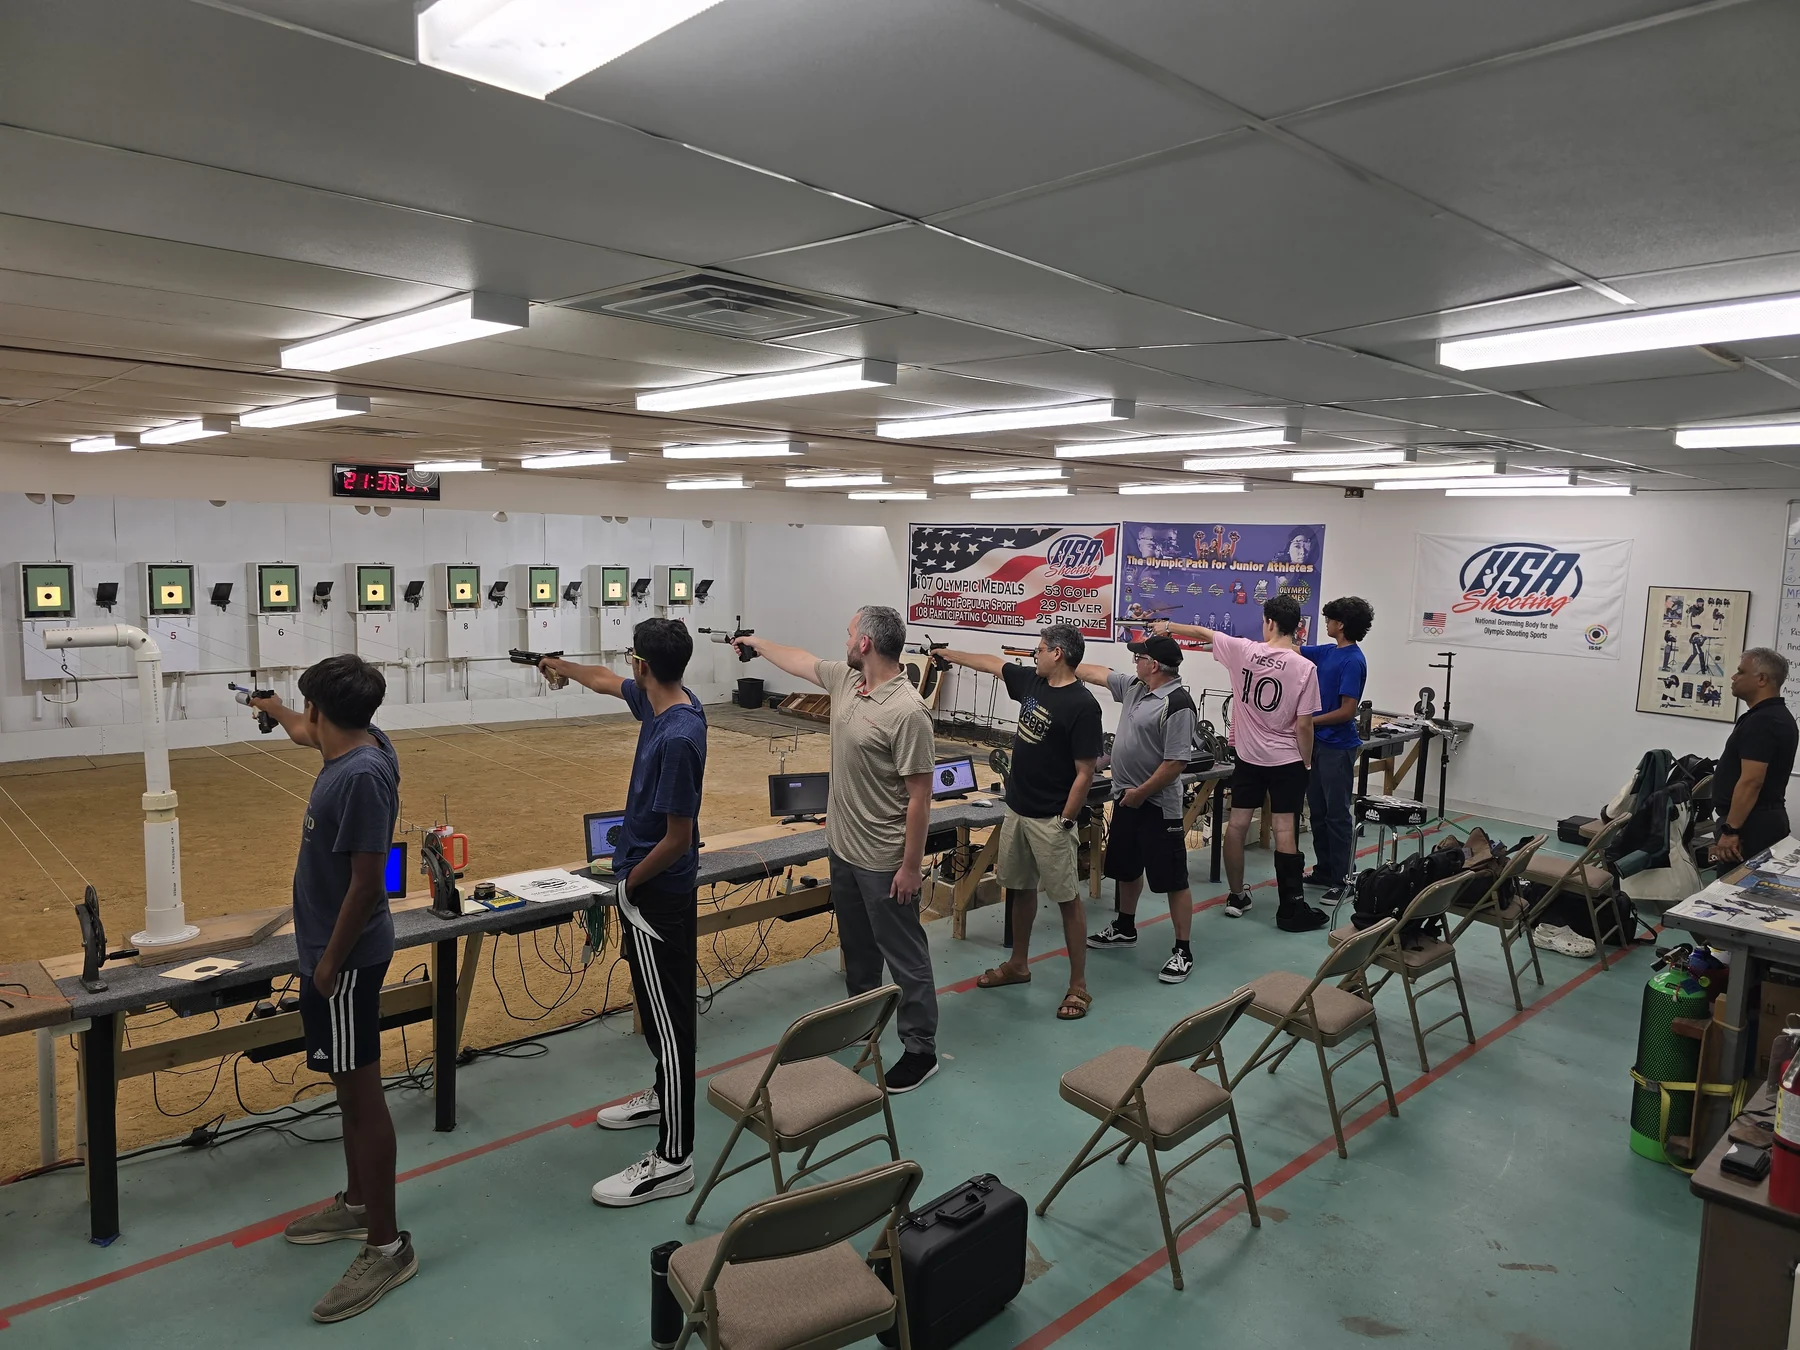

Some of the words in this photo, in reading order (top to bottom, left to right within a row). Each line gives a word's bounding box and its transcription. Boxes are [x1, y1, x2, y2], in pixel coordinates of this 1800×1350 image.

[344, 471, 430, 492] 21:30:
[1051, 539, 1103, 568] USA
[1044, 562, 1098, 578] Shooting
[1127, 555, 1144, 566] The
[1146, 557, 1183, 569] Olympic
[1186, 558, 1209, 569] Path
[1211, 560, 1227, 570] for
[1229, 561, 1264, 572] Junior
[1266, 561, 1314, 573] Athletes
[1465, 550, 1580, 598] USA
[916, 575, 934, 591] 107
[935, 577, 978, 592] OLYMPIC
[981, 579, 1025, 595] MEDALS
[1045, 585, 1061, 596] 53
[1063, 586, 1099, 598] GOLD
[936, 595, 956, 608] MOST
[956, 596, 990, 610] POPULAR
[991, 599, 1017, 612] SPORT
[1040, 599, 1057, 611] 29
[1060, 601, 1102, 614] SILVER
[1452, 589, 1571, 616] Shooting
[915, 606, 928, 618] 108
[1036, 613, 1053, 625] 25
[375, 625, 381, 633] 7
[463, 622, 469, 630] 8
[1475, 617, 1497, 625] National
[1497, 618, 1524, 629] Governing
[1525, 620, 1539, 629] Body
[1540, 621, 1548, 629] for
[1549, 622, 1559, 630] the
[170, 632, 177, 640] 5
[278, 628, 284, 637] 6
[1483, 627, 1505, 636] Olympic
[1505, 628, 1529, 638] Shooting
[1530, 630, 1548, 639] Sports
[1250, 653, 1287, 671] MESSI
[1241, 667, 1283, 712] 10
